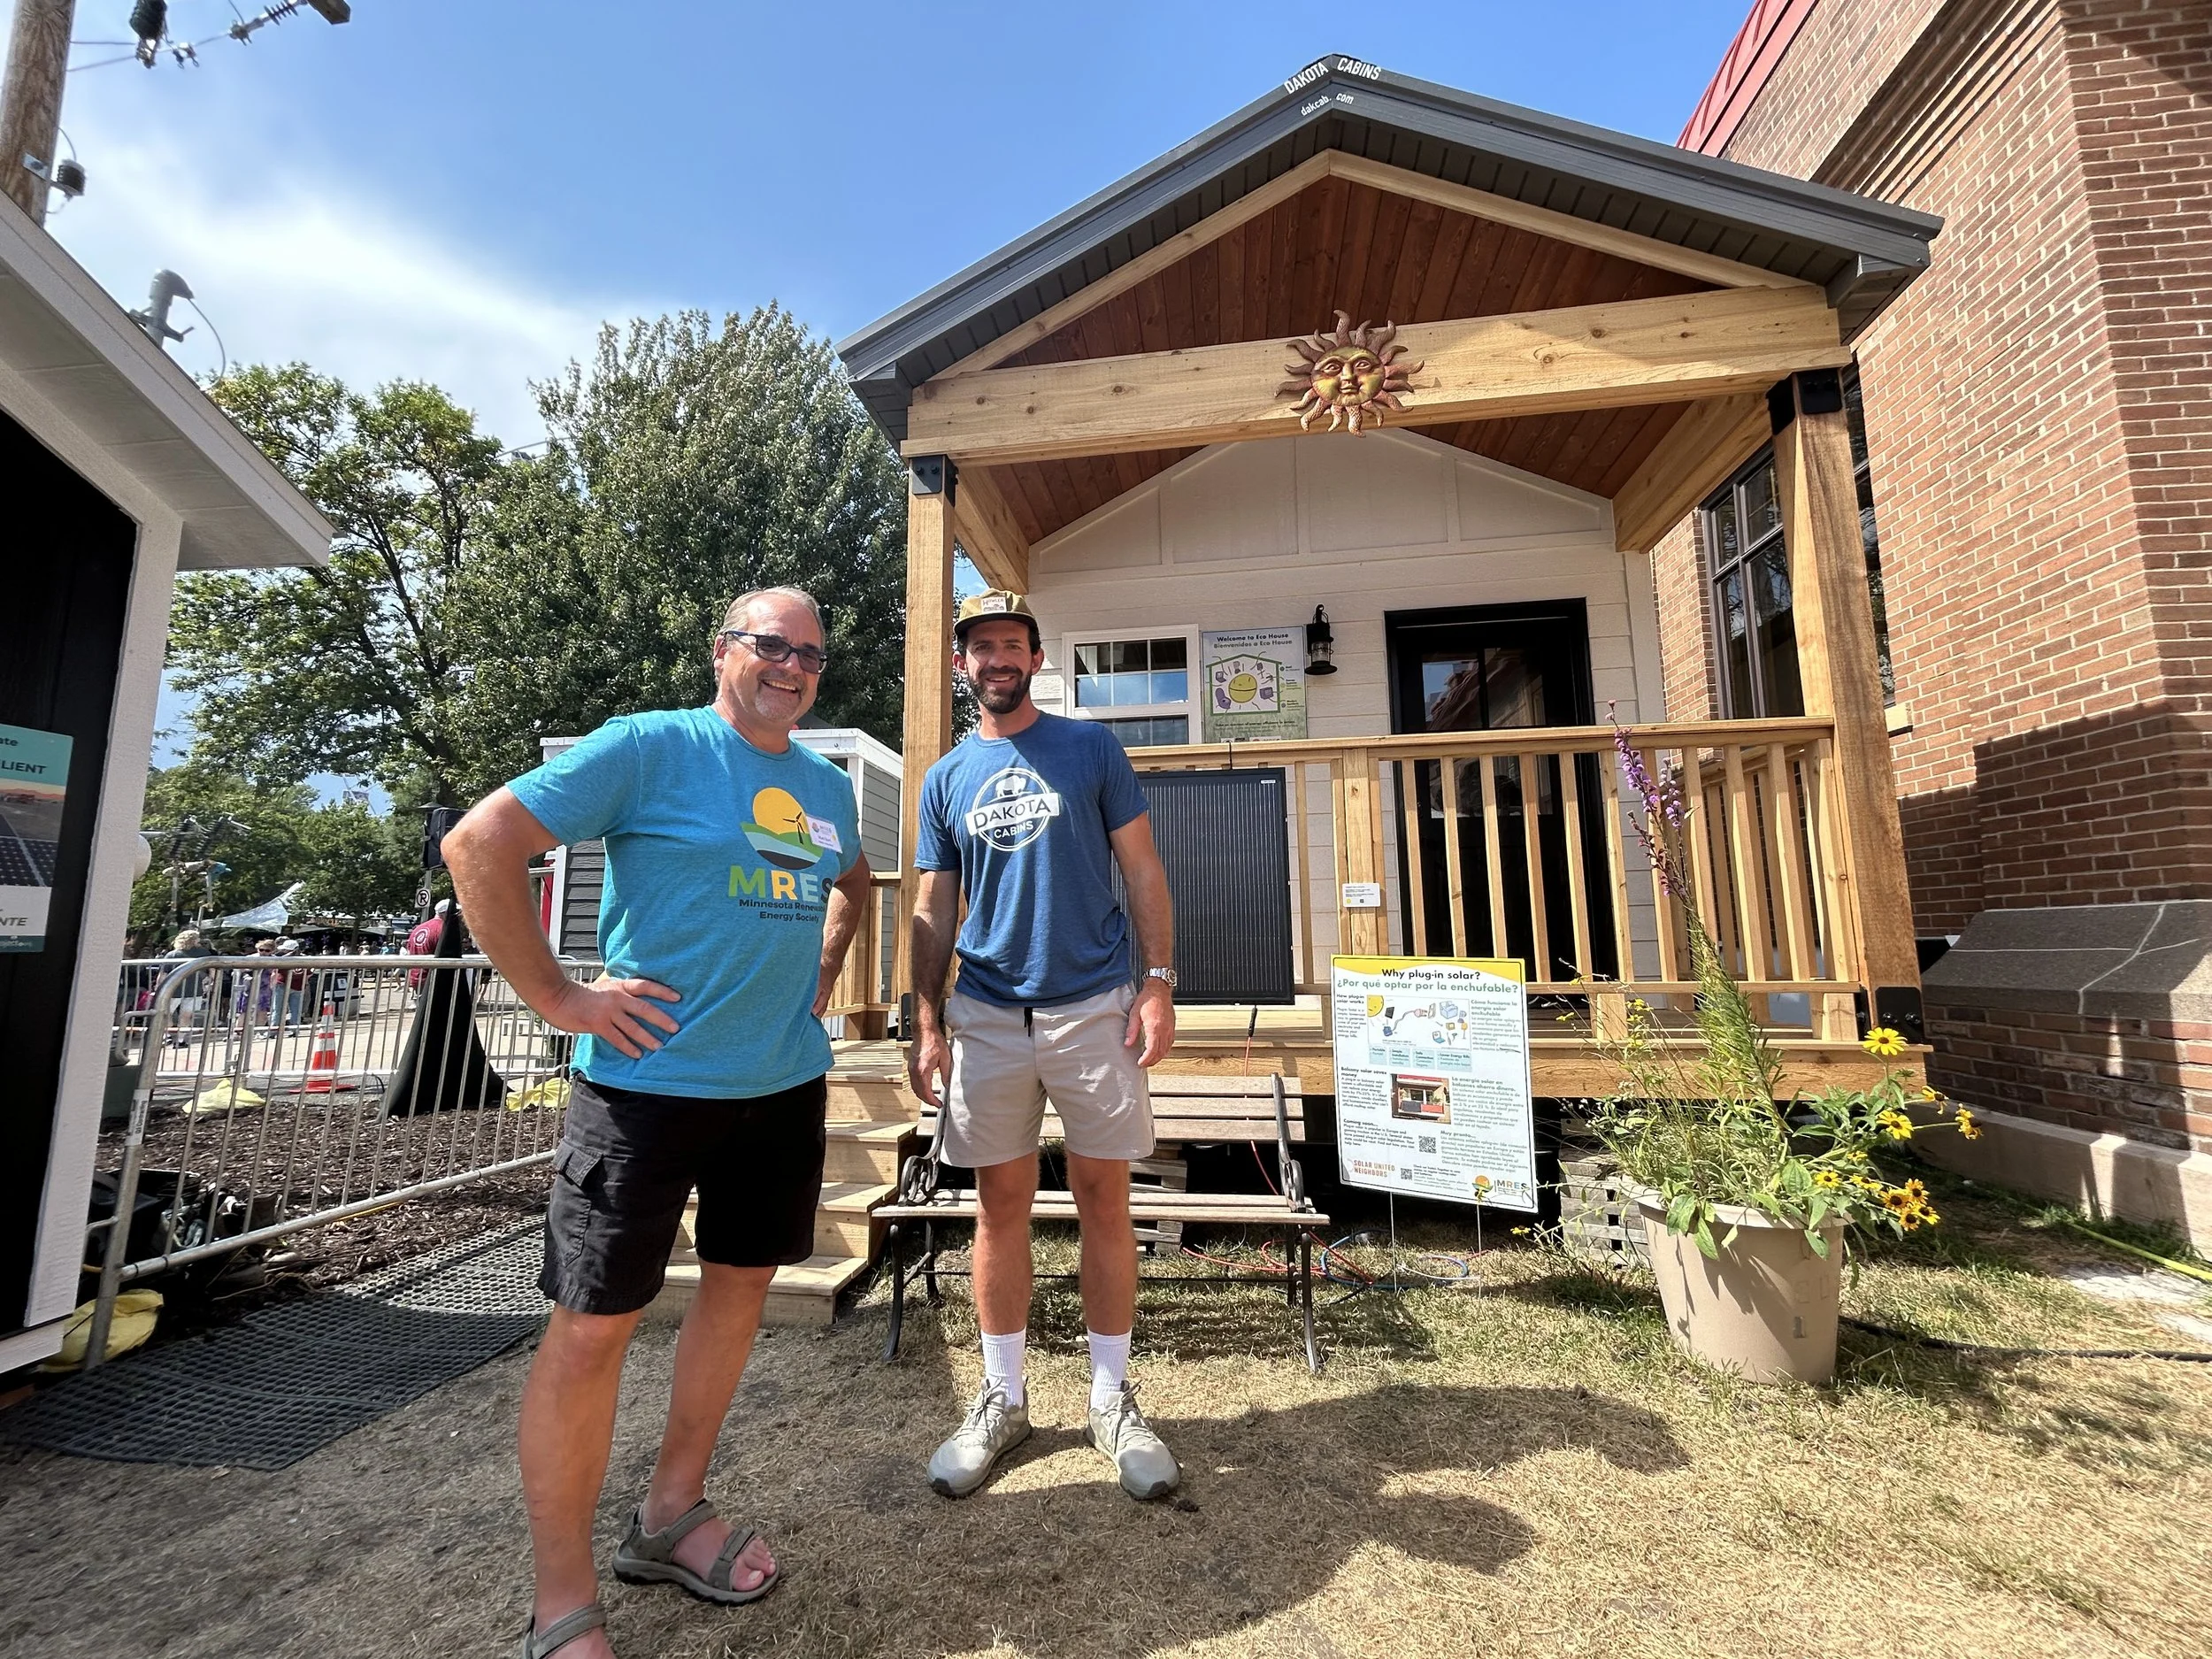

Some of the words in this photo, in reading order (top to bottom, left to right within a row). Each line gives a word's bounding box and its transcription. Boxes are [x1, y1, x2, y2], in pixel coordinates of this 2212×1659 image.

[1283, 61, 1329, 95] DAKOTA
[1337, 57, 1381, 81] CABINS
[1336, 93, 1355, 104] com
[1, 760, 48, 774] LIENT
[973, 798, 1051, 829] DAKOTA
[994, 820, 1033, 839] CABINS
[727, 864, 834, 903] MRES
[739, 899, 793, 910] Minnesota
[759, 911, 795, 921] Energy
[795, 913, 819, 924] Society
[1381, 968, 1405, 979] Why
[1408, 970, 1444, 981] plug-in
[1448, 972, 1481, 980] solar?
[1337, 979, 1359, 988] ¿Por
[1363, 979, 1381, 990] qué
[1384, 981, 1413, 990] optar
[1416, 983, 1434, 992] por
[1437, 981, 1447, 990] la
[1450, 982, 1518, 993] enchufable?
[1354, 1167, 1388, 1178] NEIGHBORS
[1373, 1163, 1395, 1171] UNITED
[1497, 1179, 1527, 1190] MRES
